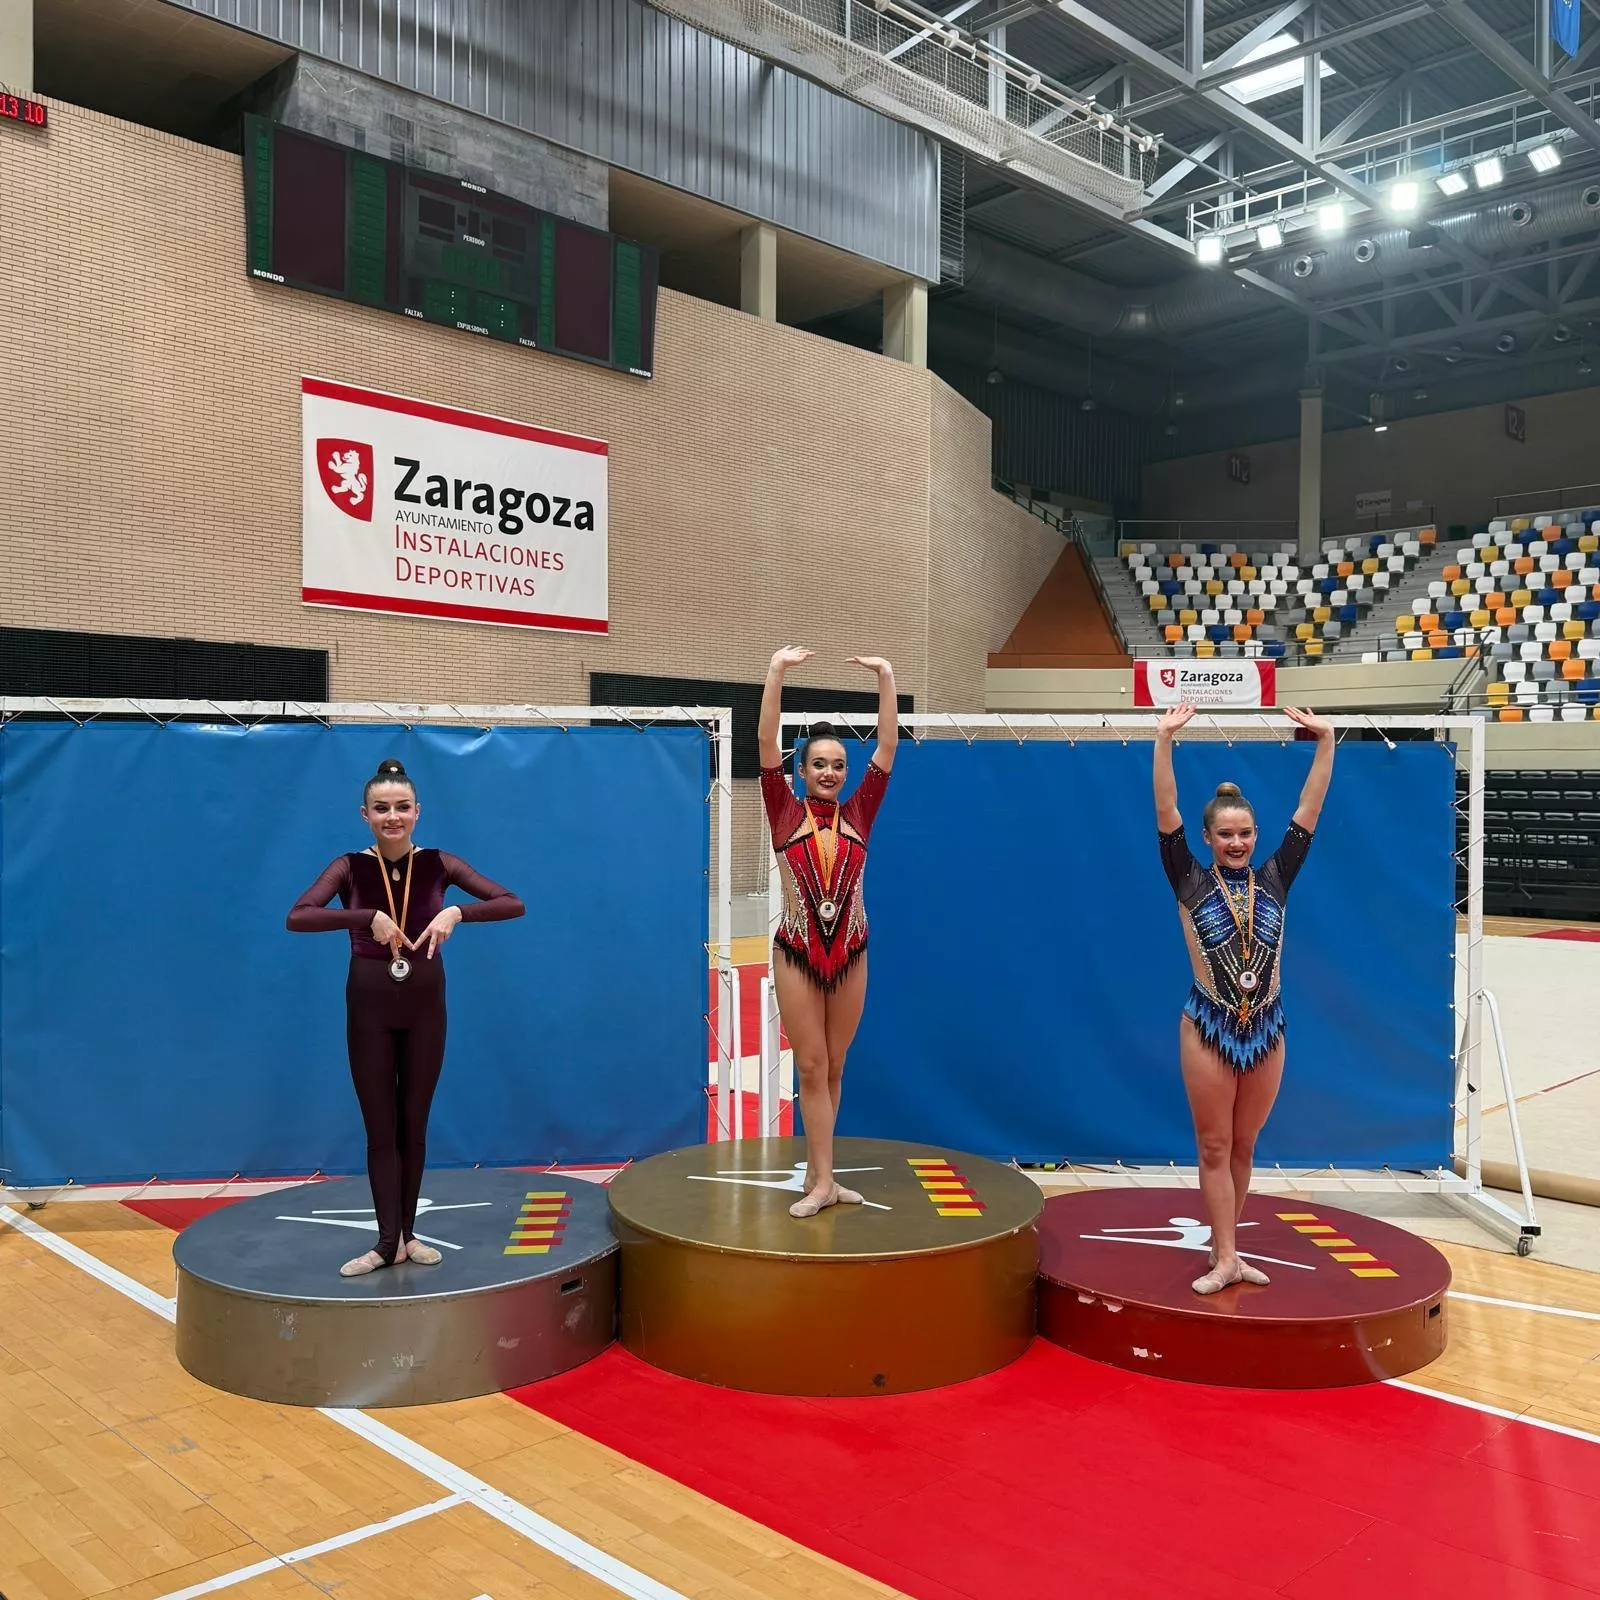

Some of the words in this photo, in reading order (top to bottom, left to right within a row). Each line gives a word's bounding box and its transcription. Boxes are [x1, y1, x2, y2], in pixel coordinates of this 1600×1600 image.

[461, 180, 487, 194] MONDO
[463, 234, 486, 248] PERIODO
[253, 268, 285, 283] MONDO
[404, 307, 424, 319] FALTAS
[456, 321, 489, 336] EXPULSIONES
[519, 337, 537, 348] FALTAS
[629, 366, 652, 378] MONDO
[394, 456, 595, 535] Zaragoza
[395, 510, 494, 535] AYUNTAMIENTO
[395, 524, 565, 571] INSTALACIONES
[395, 556, 535, 597] DEPORTIVAS
[1180, 670, 1243, 686] Zaragoza
[1180, 695, 1224, 703] DEPORTIVAS
